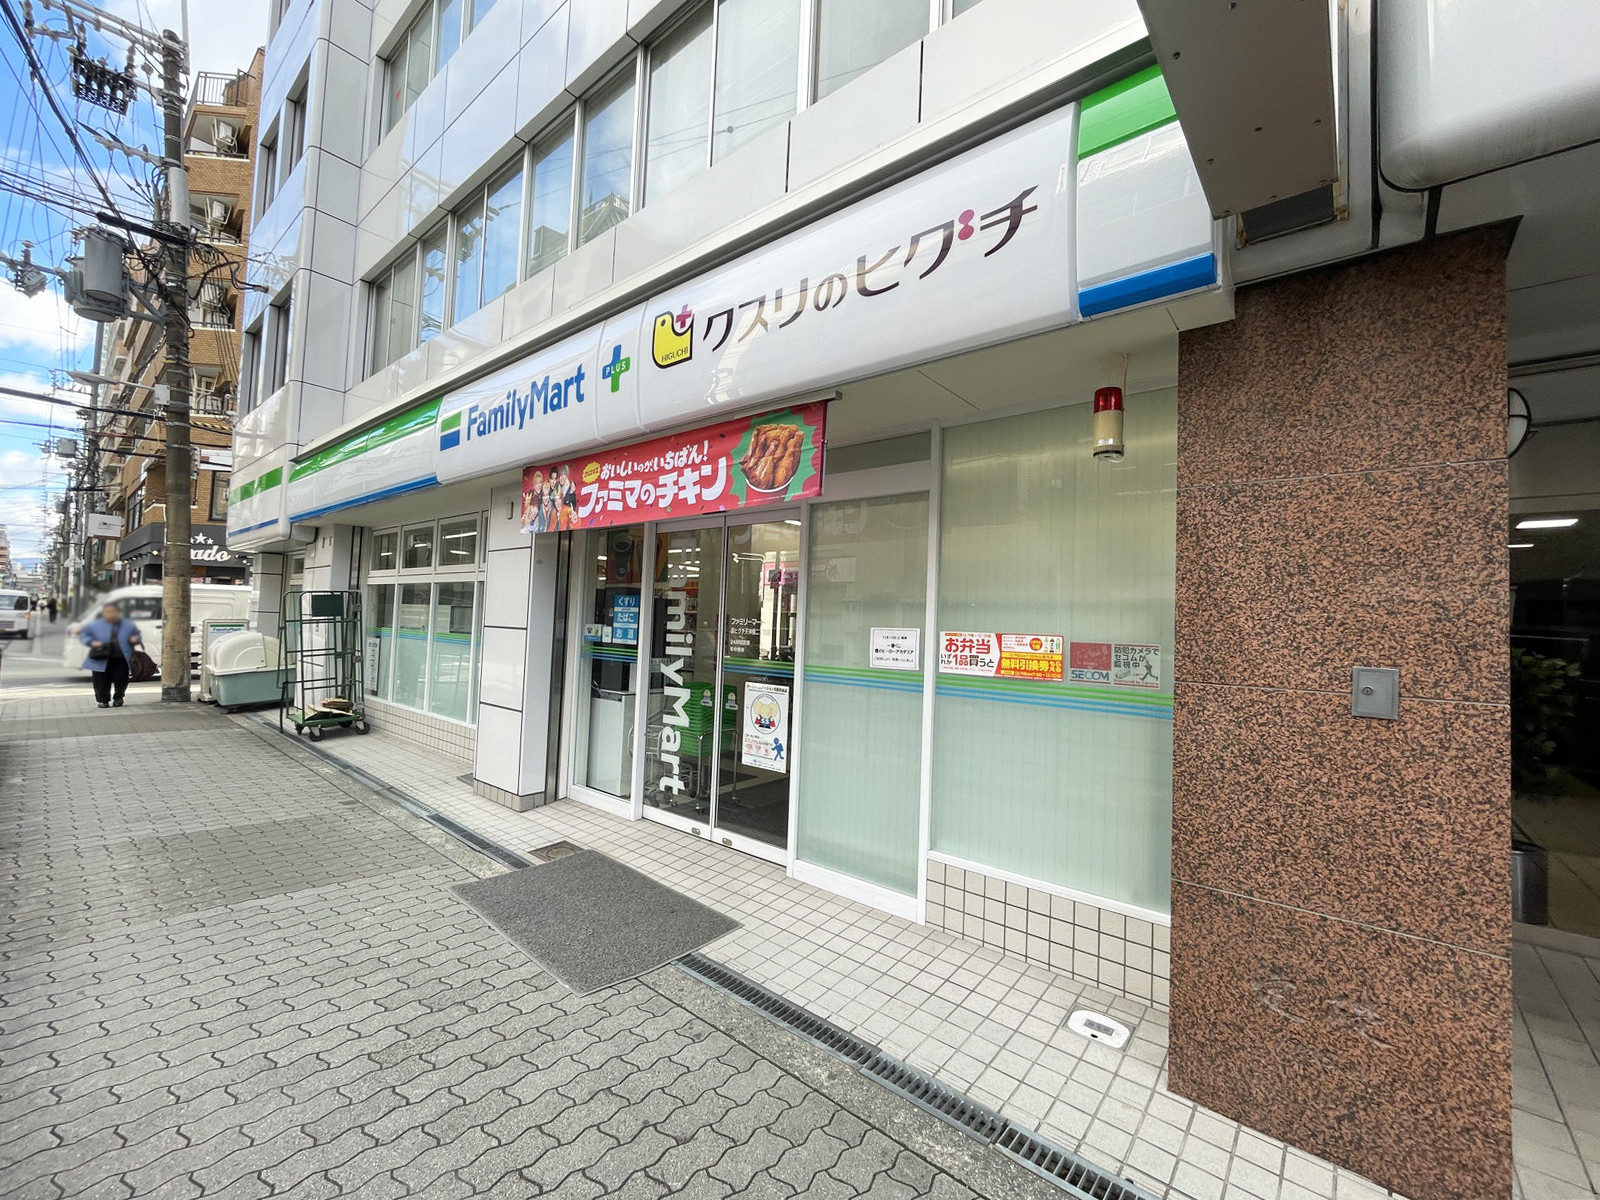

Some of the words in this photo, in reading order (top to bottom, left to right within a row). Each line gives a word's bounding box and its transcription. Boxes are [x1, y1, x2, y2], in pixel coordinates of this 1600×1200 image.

[702, 184, 1039, 351] クスリのヒグチ
[661, 346, 688, 363] HIGUCHI
[605, 361, 626, 376] PLUS
[466, 364, 585, 440] FamilyMart
[577, 457, 727, 518] ファミマのチキン
[618, 596, 636, 606] くすり
[617, 613, 634, 622] たばこ
[731, 618, 765, 626] ファミリーマー
[944, 637, 991, 655] お弁当
[1114, 646, 1159, 656] 防犯カメラで
[1114, 654, 1146, 662] セコムが
[1114, 660, 1140, 669] 監視中
[1001, 658, 1049, 672] 無料引換券
[1071, 669, 1109, 681] SECOM
